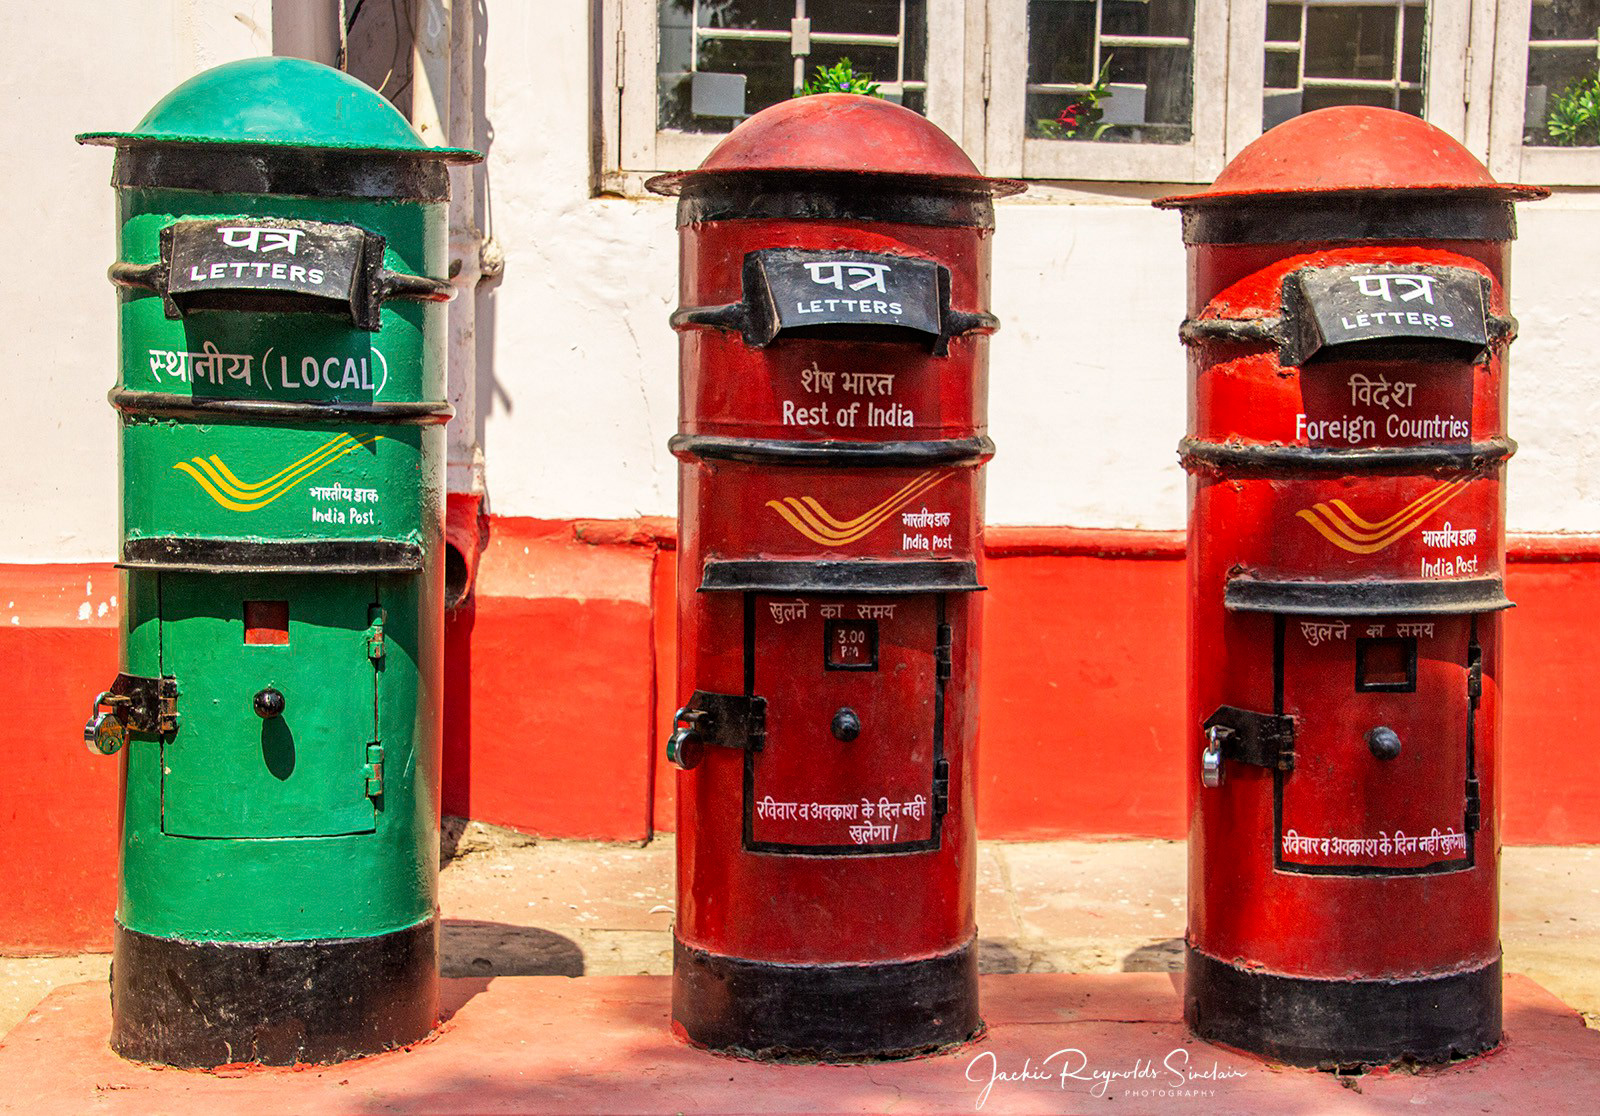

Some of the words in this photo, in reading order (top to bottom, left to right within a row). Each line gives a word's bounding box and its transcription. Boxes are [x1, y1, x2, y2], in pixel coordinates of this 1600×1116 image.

[217, 226, 305, 255] पत्र
[190, 262, 324, 284] LETTERS
[803, 261, 891, 293] पत्र
[1350, 274, 1436, 304] पत्र
[797, 299, 903, 315] LETTERS
[1341, 312, 1454, 330] LETTERS
[149, 340, 253, 386] स्थानीय
[262, 346, 388, 396] (LOCAL)
[801, 361, 835, 394] शेष
[841, 372, 895, 396] भारत
[1348, 373, 1416, 409] विदेश
[783, 400, 829, 426] Rest
[836, 402, 860, 427] of
[868, 402, 914, 427] India
[1296, 413, 1376, 443] Foreign
[1386, 413, 1469, 438] Countries
[309, 482, 353, 502] भारतीय
[354, 488, 379, 503] डाक
[312, 507, 345, 525] India
[350, 507, 375, 525] Post
[902, 507, 934, 528] भारतीय
[934, 513, 951, 527] डाक
[903, 533, 929, 550] India
[933, 534, 952, 550] Post
[1422, 521, 1459, 548] भारतीय
[1459, 529, 1477, 546] डाक
[1422, 557, 1454, 578] India
[1456, 554, 1478, 574] Post
[769, 598, 809, 625] खुलने
[820, 604, 844, 619] का
[857, 604, 897, 619] समय
[838, 629, 865, 644] 3.00
[1300, 620, 1351, 647] खुलने
[1366, 624, 1385, 638] का
[1397, 623, 1435, 639] समय
[756, 795, 798, 821] रविवार
[798, 803, 810, 821] व
[810, 802, 859, 821] अवकाश
[861, 797, 875, 819] के
[877, 796, 901, 820] दिन
[902, 794, 927, 821] नहीं
[1282, 829, 1320, 855] रविवार
[1320, 838, 1331, 857] व
[1330, 836, 1378, 858] अवकाश
[1379, 831, 1393, 856] के
[1393, 830, 1418, 856] दिन
